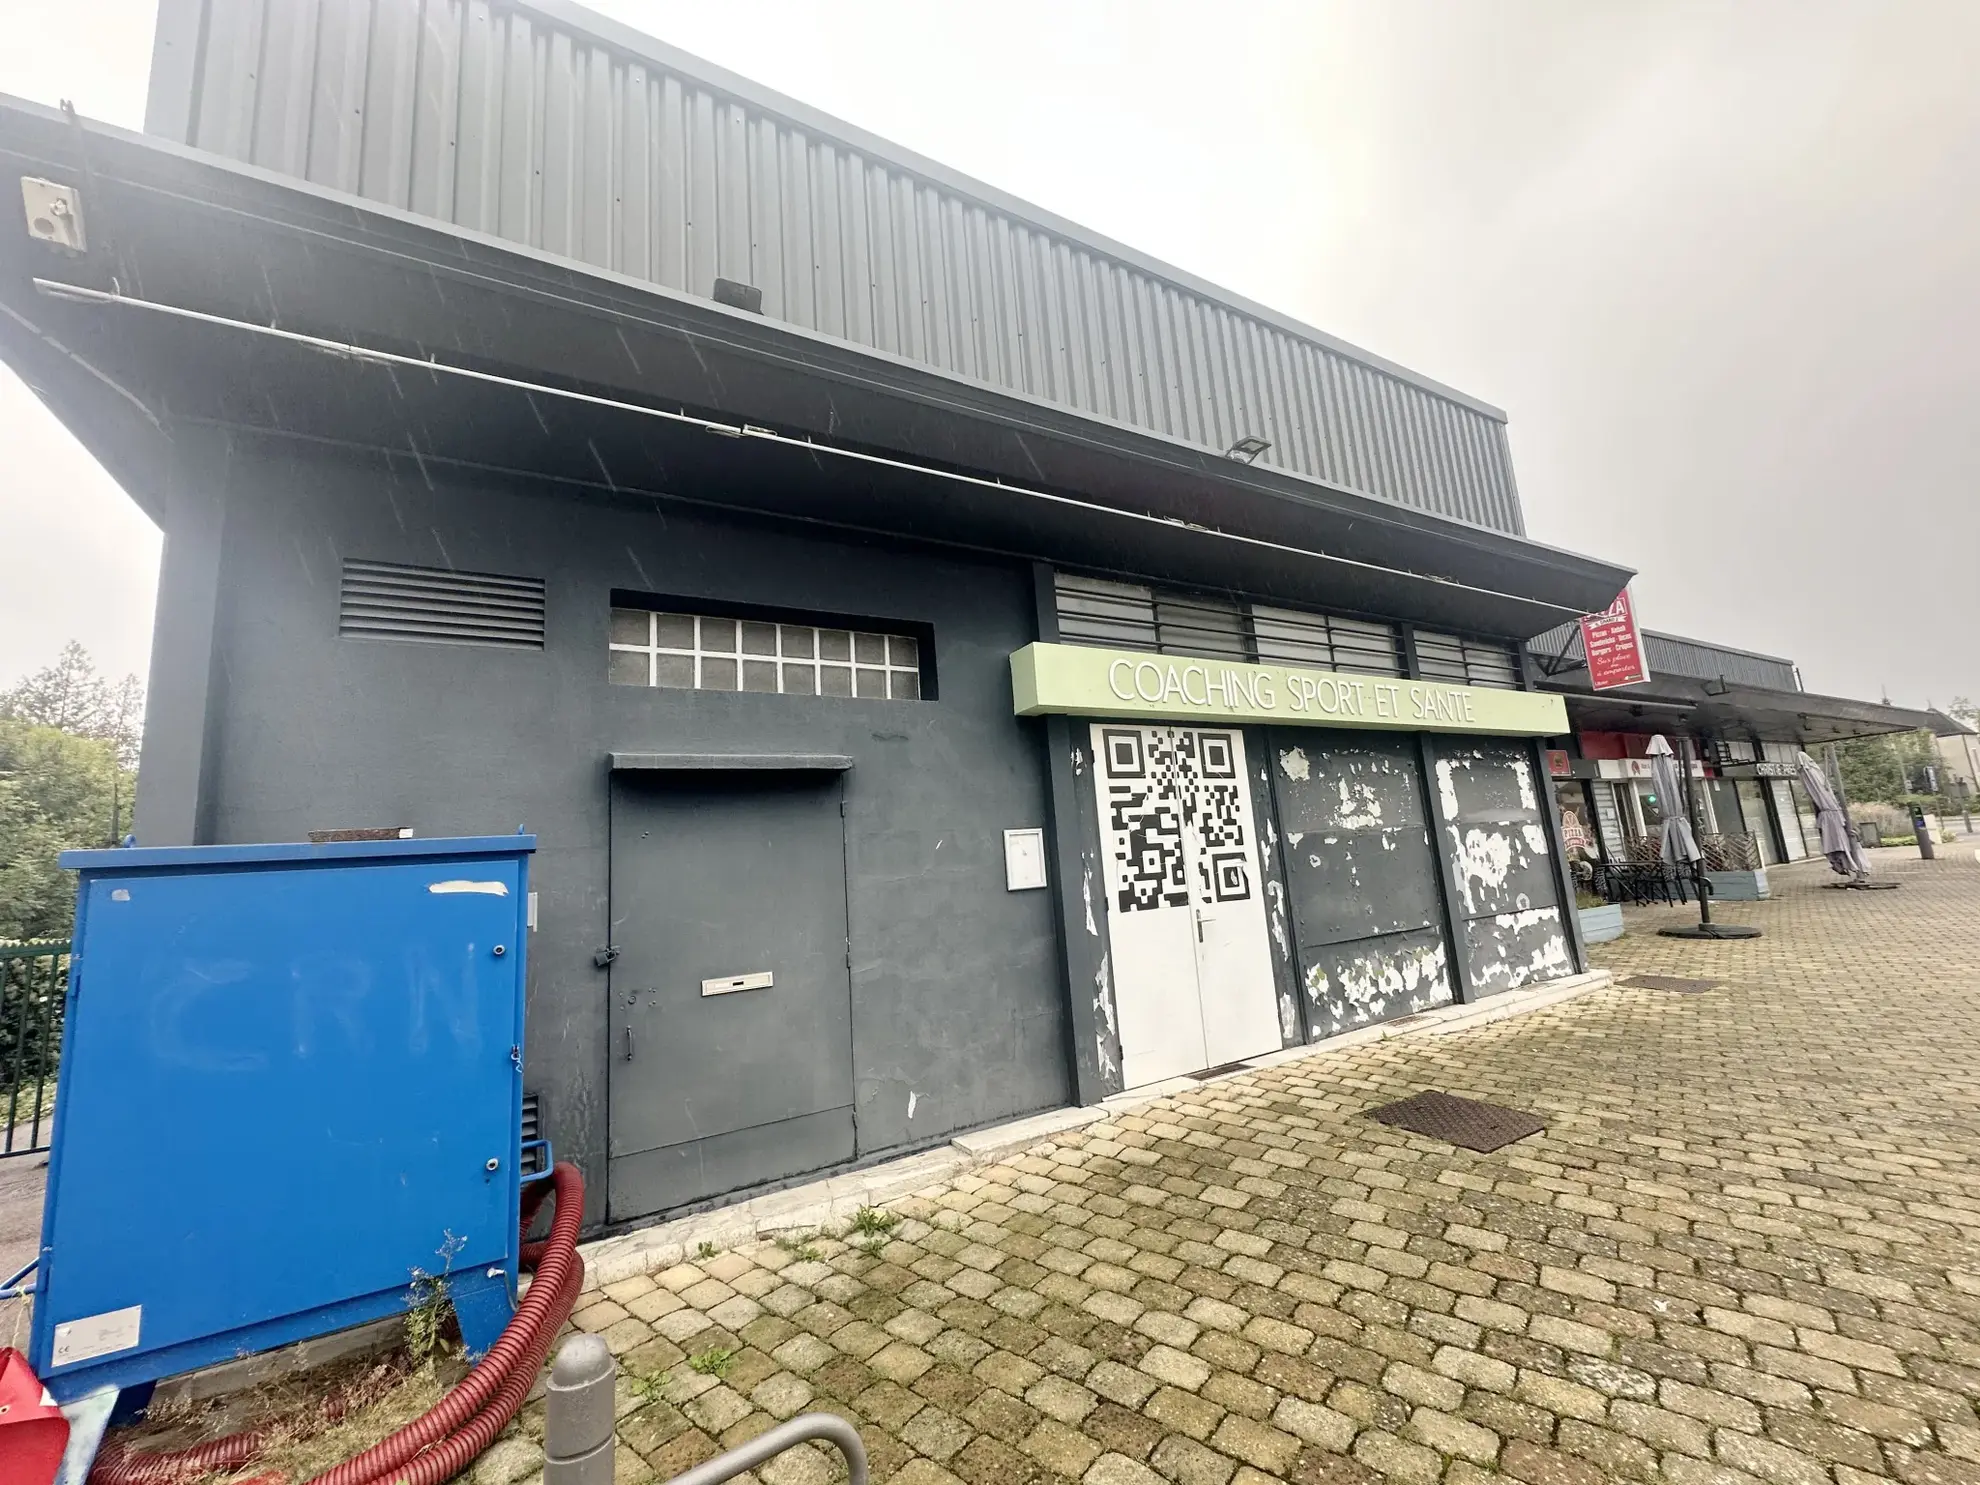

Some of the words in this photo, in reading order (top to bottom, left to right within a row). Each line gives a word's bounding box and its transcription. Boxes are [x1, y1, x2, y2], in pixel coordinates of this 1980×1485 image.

[1108, 658, 1276, 710] COACHING
[1286, 675, 1365, 716] SPORT
[1373, 684, 1400, 718] ET
